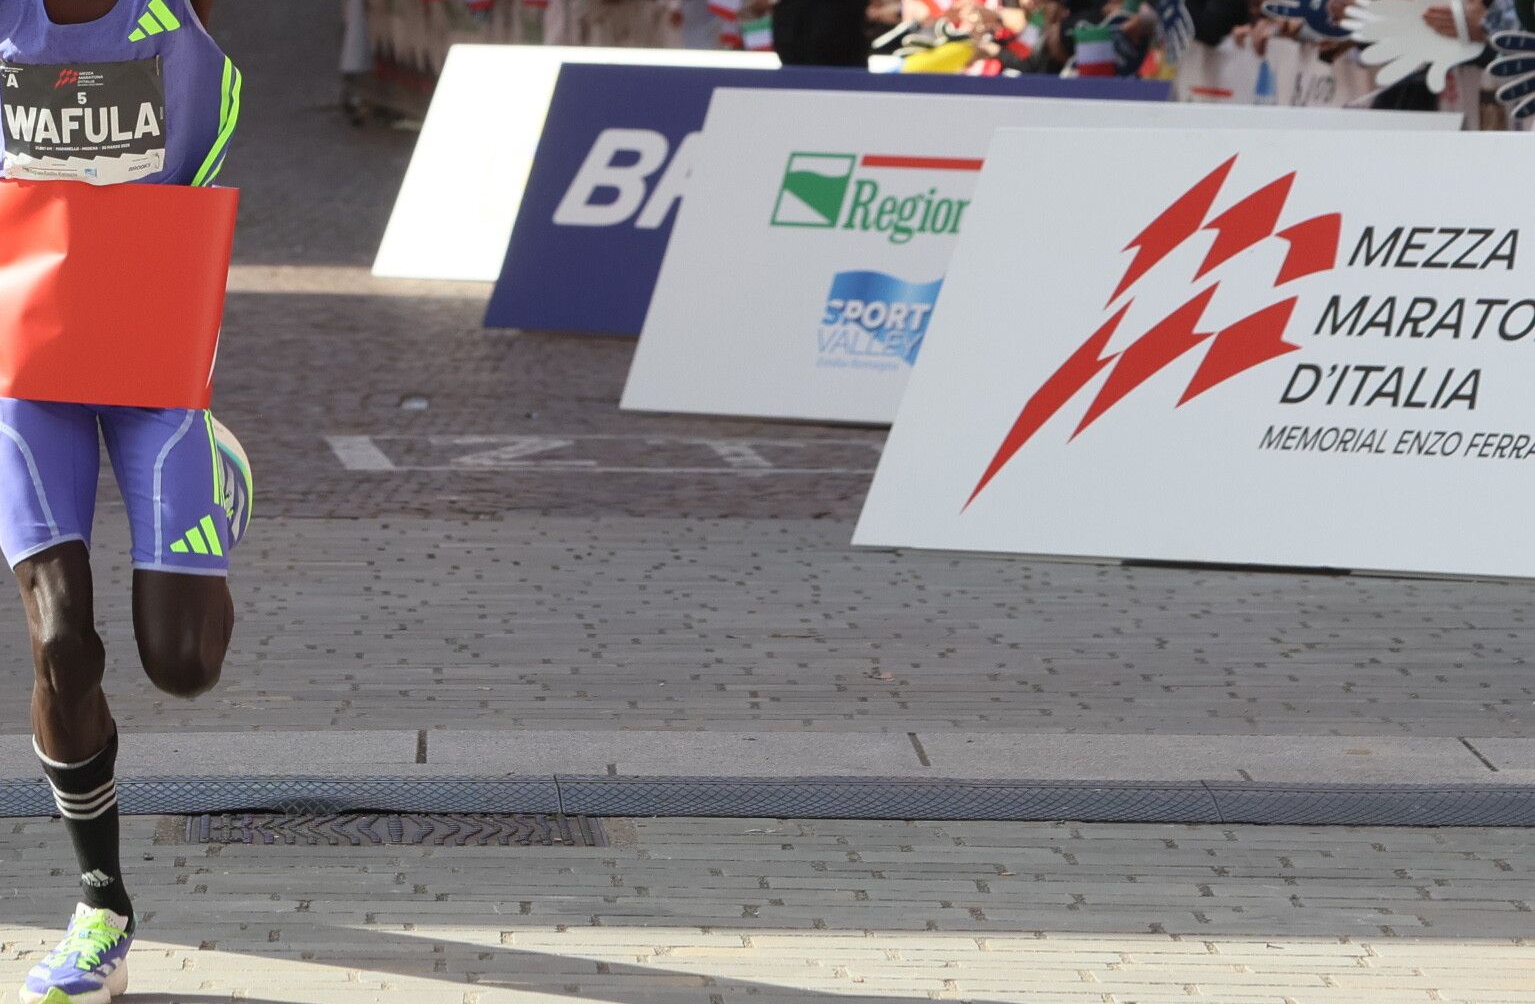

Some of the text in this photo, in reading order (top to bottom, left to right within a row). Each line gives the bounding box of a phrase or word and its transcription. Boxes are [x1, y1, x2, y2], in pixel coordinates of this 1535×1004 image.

[6, 73, 19, 88] A
[77, 92, 87, 105] 5
[4, 102, 160, 144] WAFULA
[1346, 225, 1520, 271] MEZZA
[822, 298, 932, 332] SPORT
[817, 326, 925, 358] VALLEY
[1279, 362, 1482, 411] D'ITALIA
[1258, 424, 1389, 454] MEMORIAL
[1392, 429, 1463, 457] ENZO
